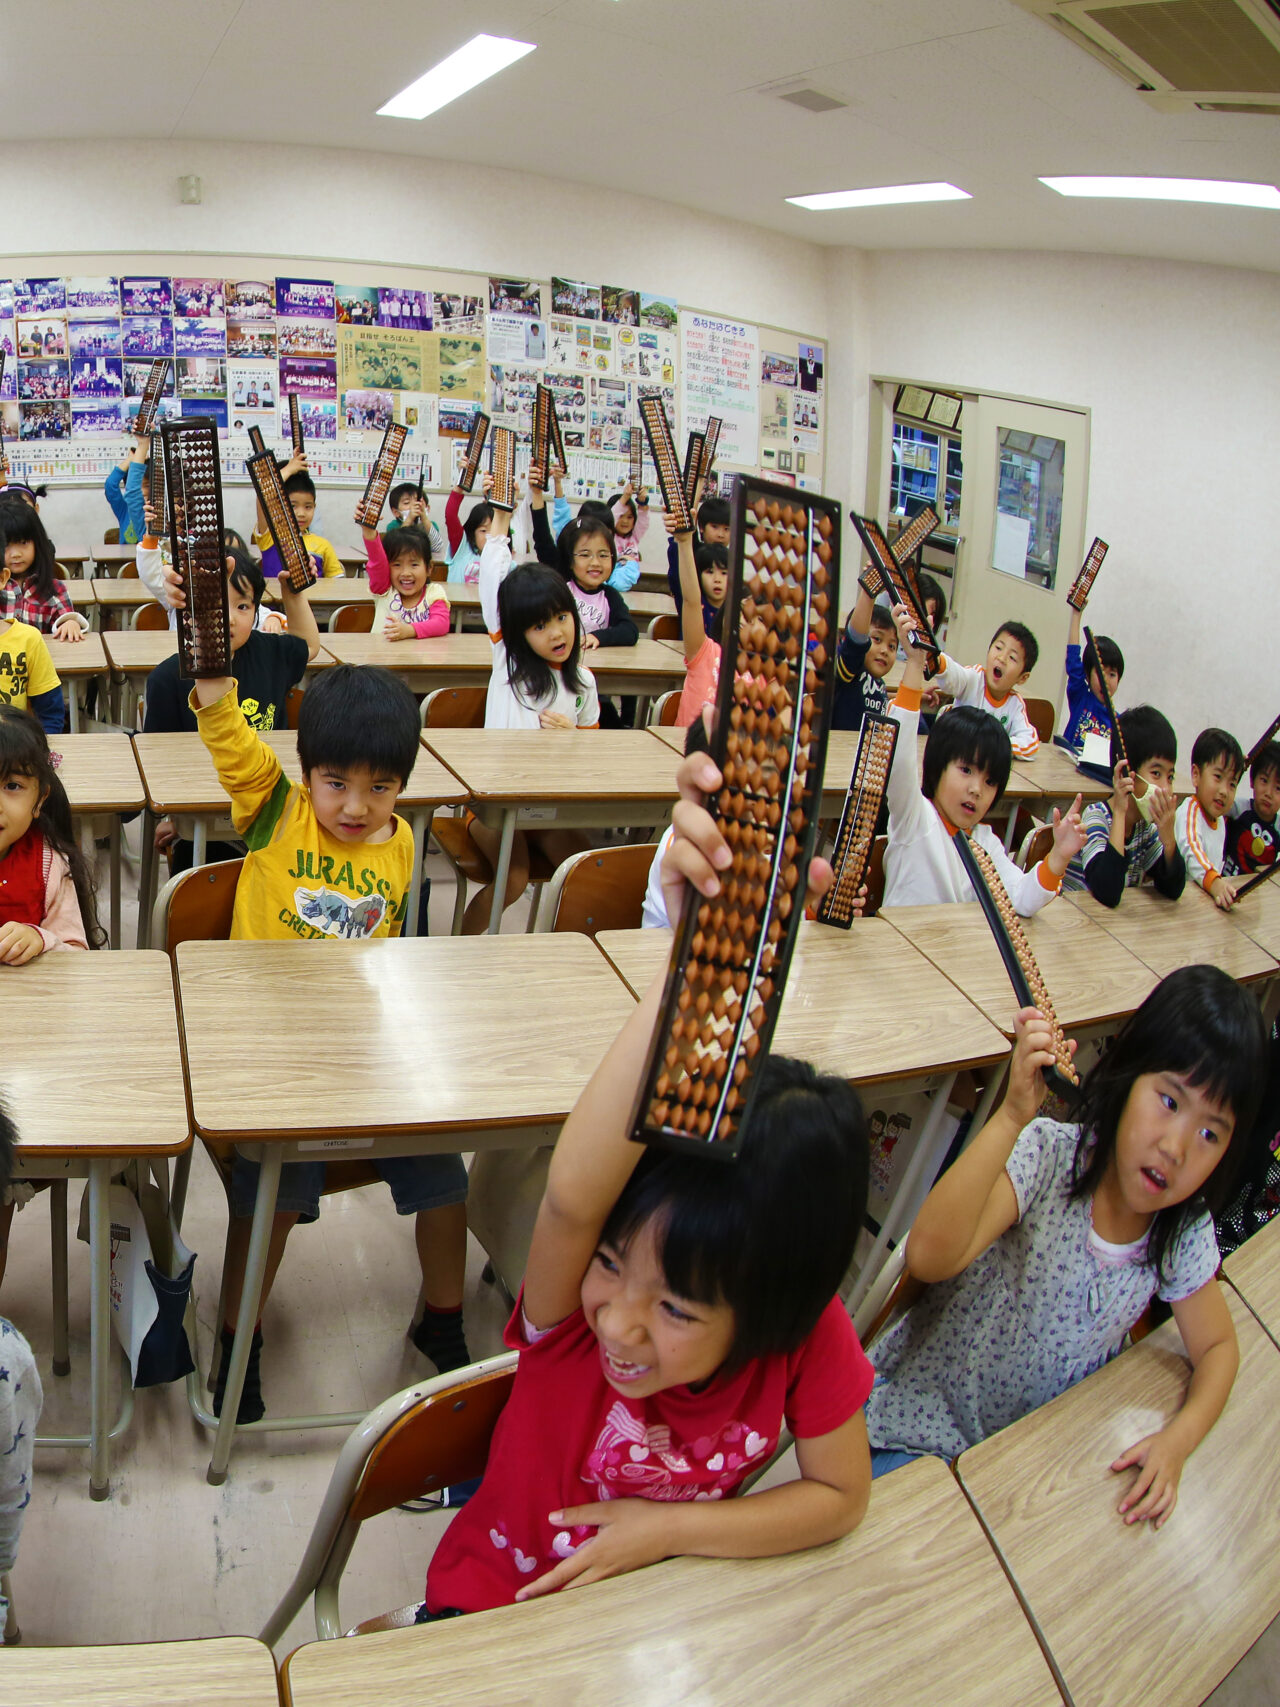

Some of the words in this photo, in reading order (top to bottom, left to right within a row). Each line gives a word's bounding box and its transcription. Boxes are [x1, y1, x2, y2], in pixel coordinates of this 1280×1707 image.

[693, 317, 746, 337] あなたはできる
[383, 335, 415, 343] そろばん王
